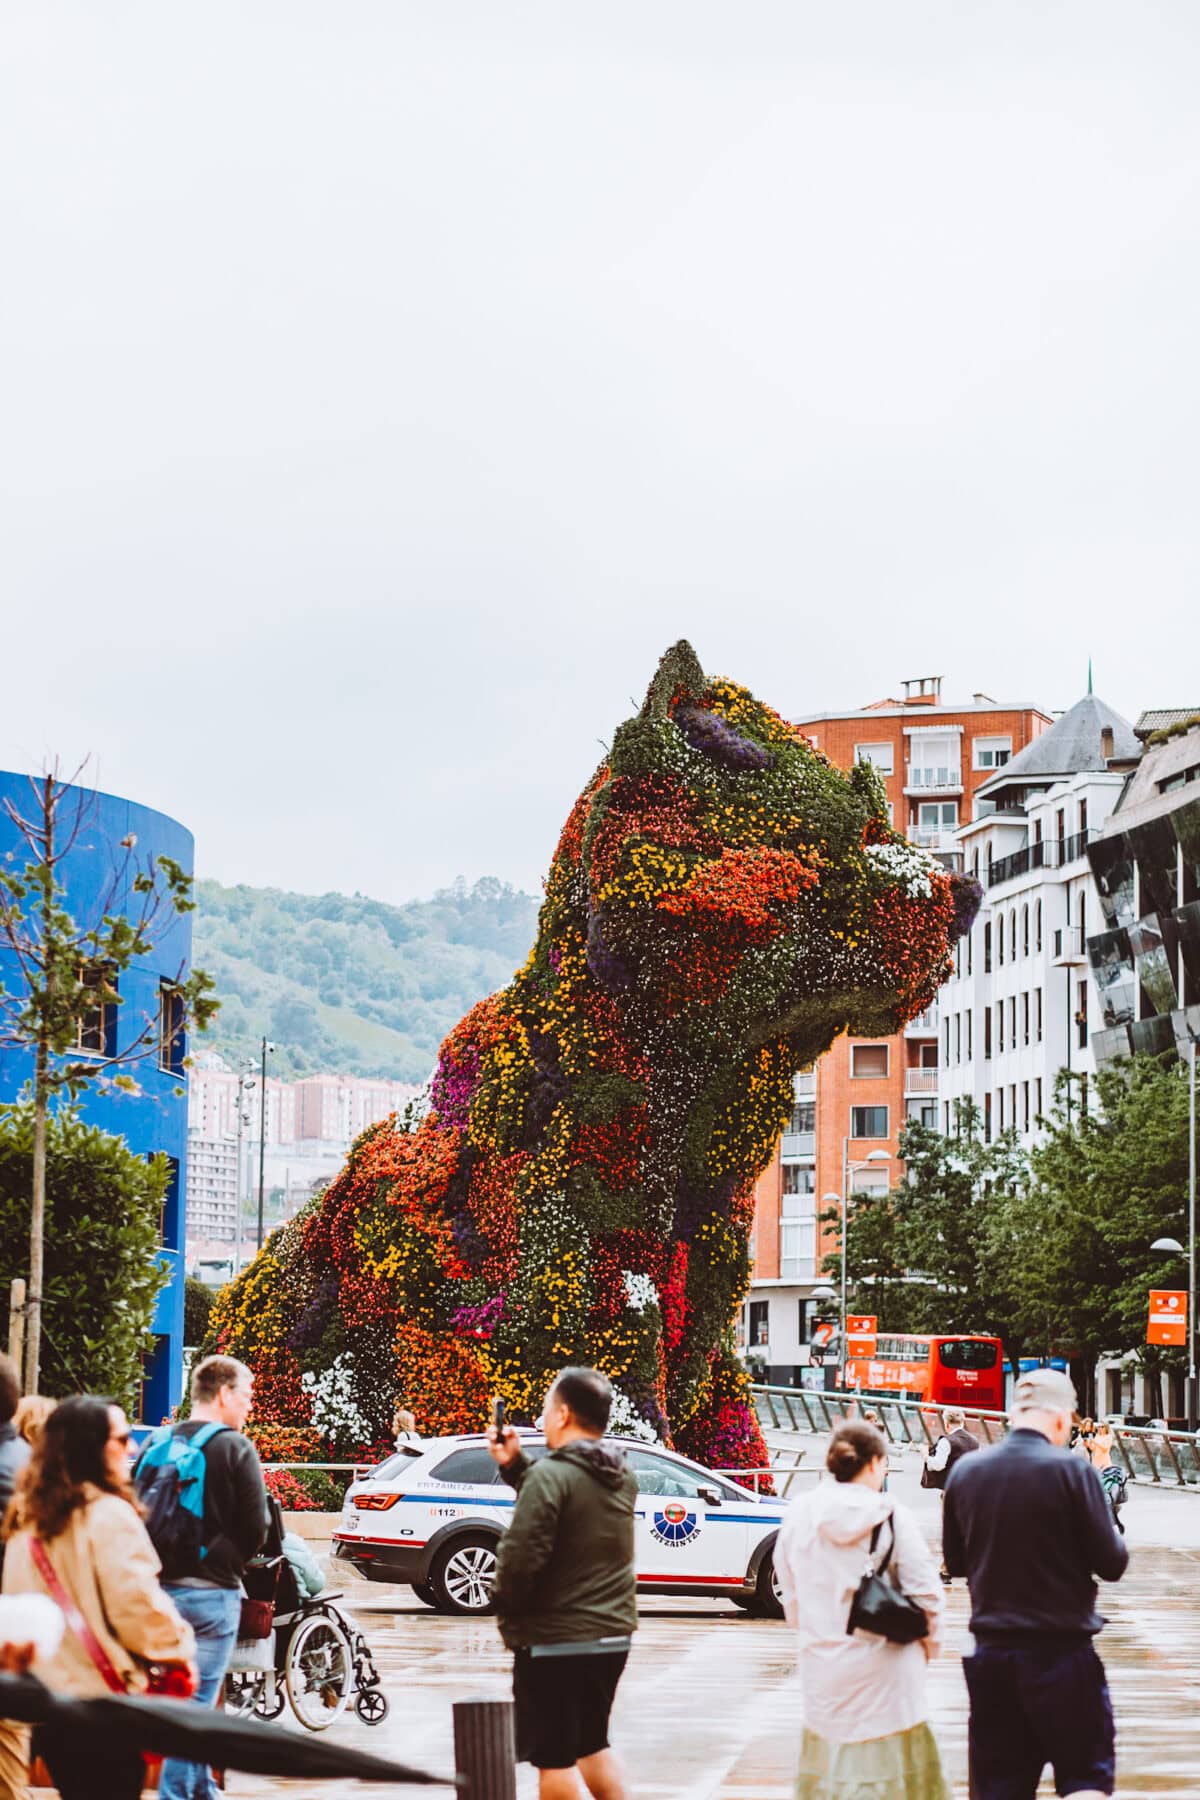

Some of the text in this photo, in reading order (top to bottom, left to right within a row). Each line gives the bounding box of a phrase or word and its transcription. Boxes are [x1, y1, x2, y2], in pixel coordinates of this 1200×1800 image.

[417, 1481, 474, 1491] ERTZAINTZA
[438, 1509, 456, 1517] 112
[649, 1528, 702, 1548] ERTZAINTZA
